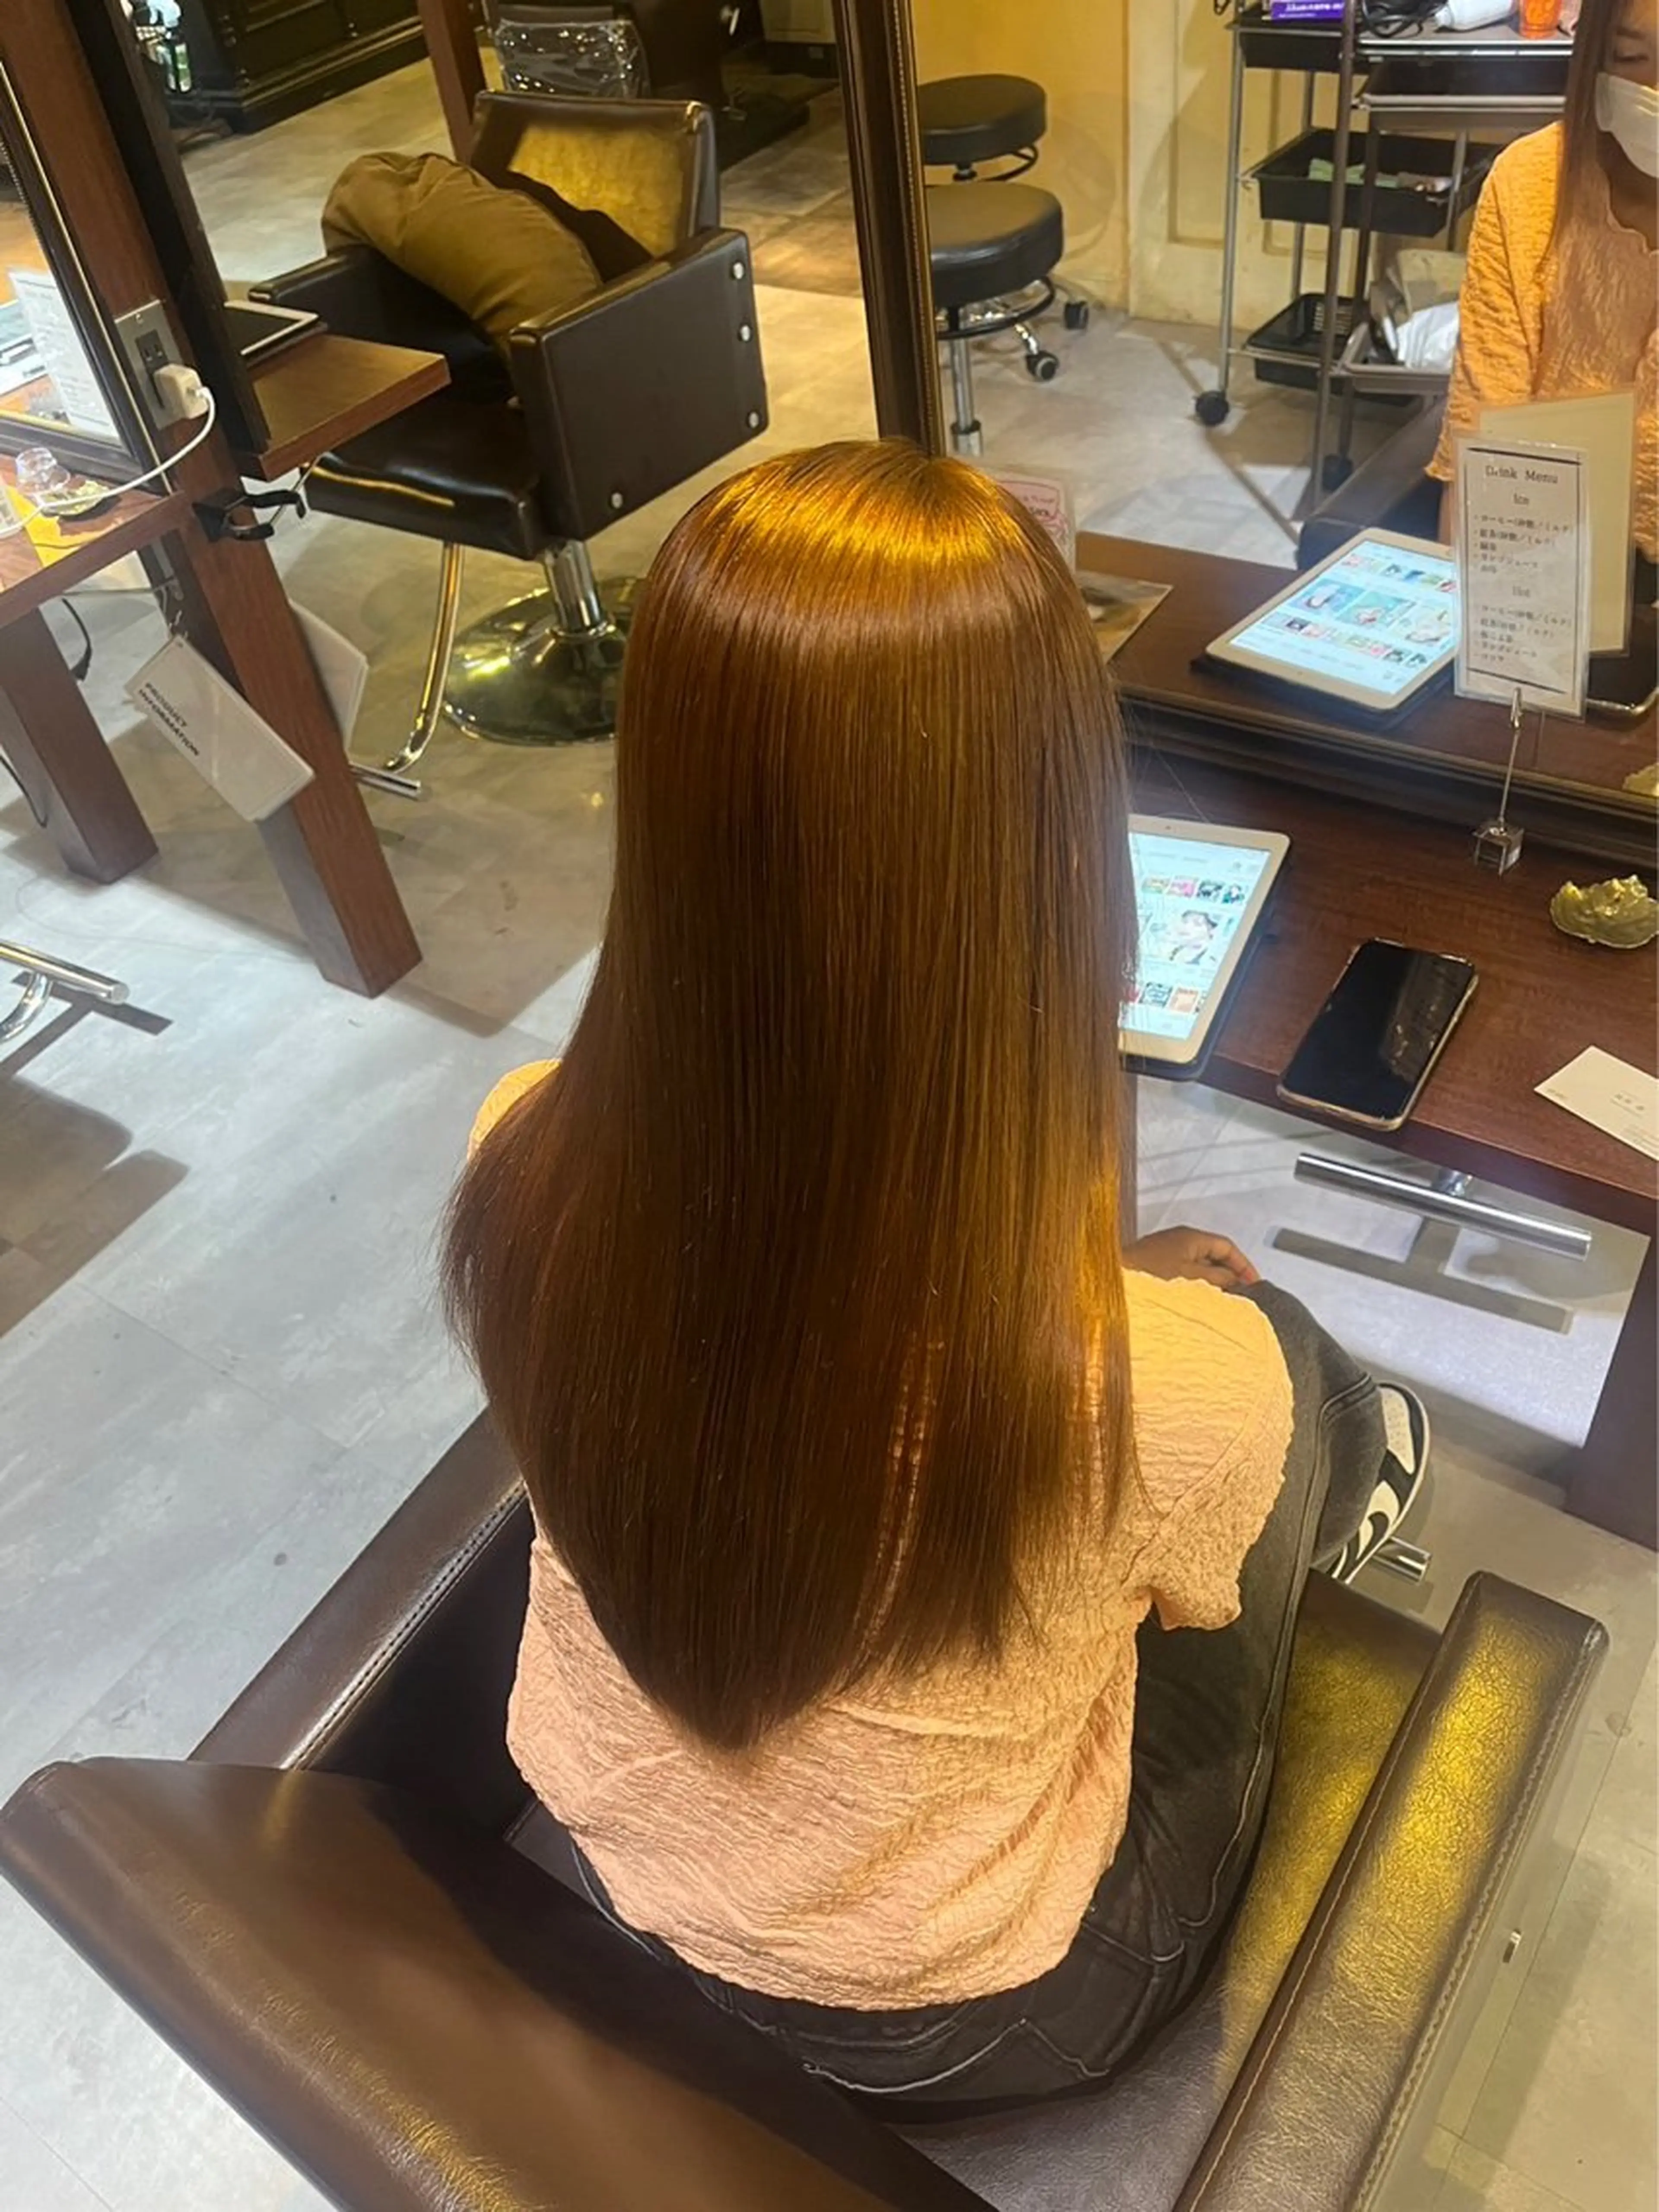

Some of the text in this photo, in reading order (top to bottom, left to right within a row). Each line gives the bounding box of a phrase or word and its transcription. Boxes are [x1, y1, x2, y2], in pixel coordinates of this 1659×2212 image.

[1485, 465, 1558, 484] Drink Menu
[138, 689, 200, 756] INFORMATION
[145, 682, 188, 727] PRODUCT
